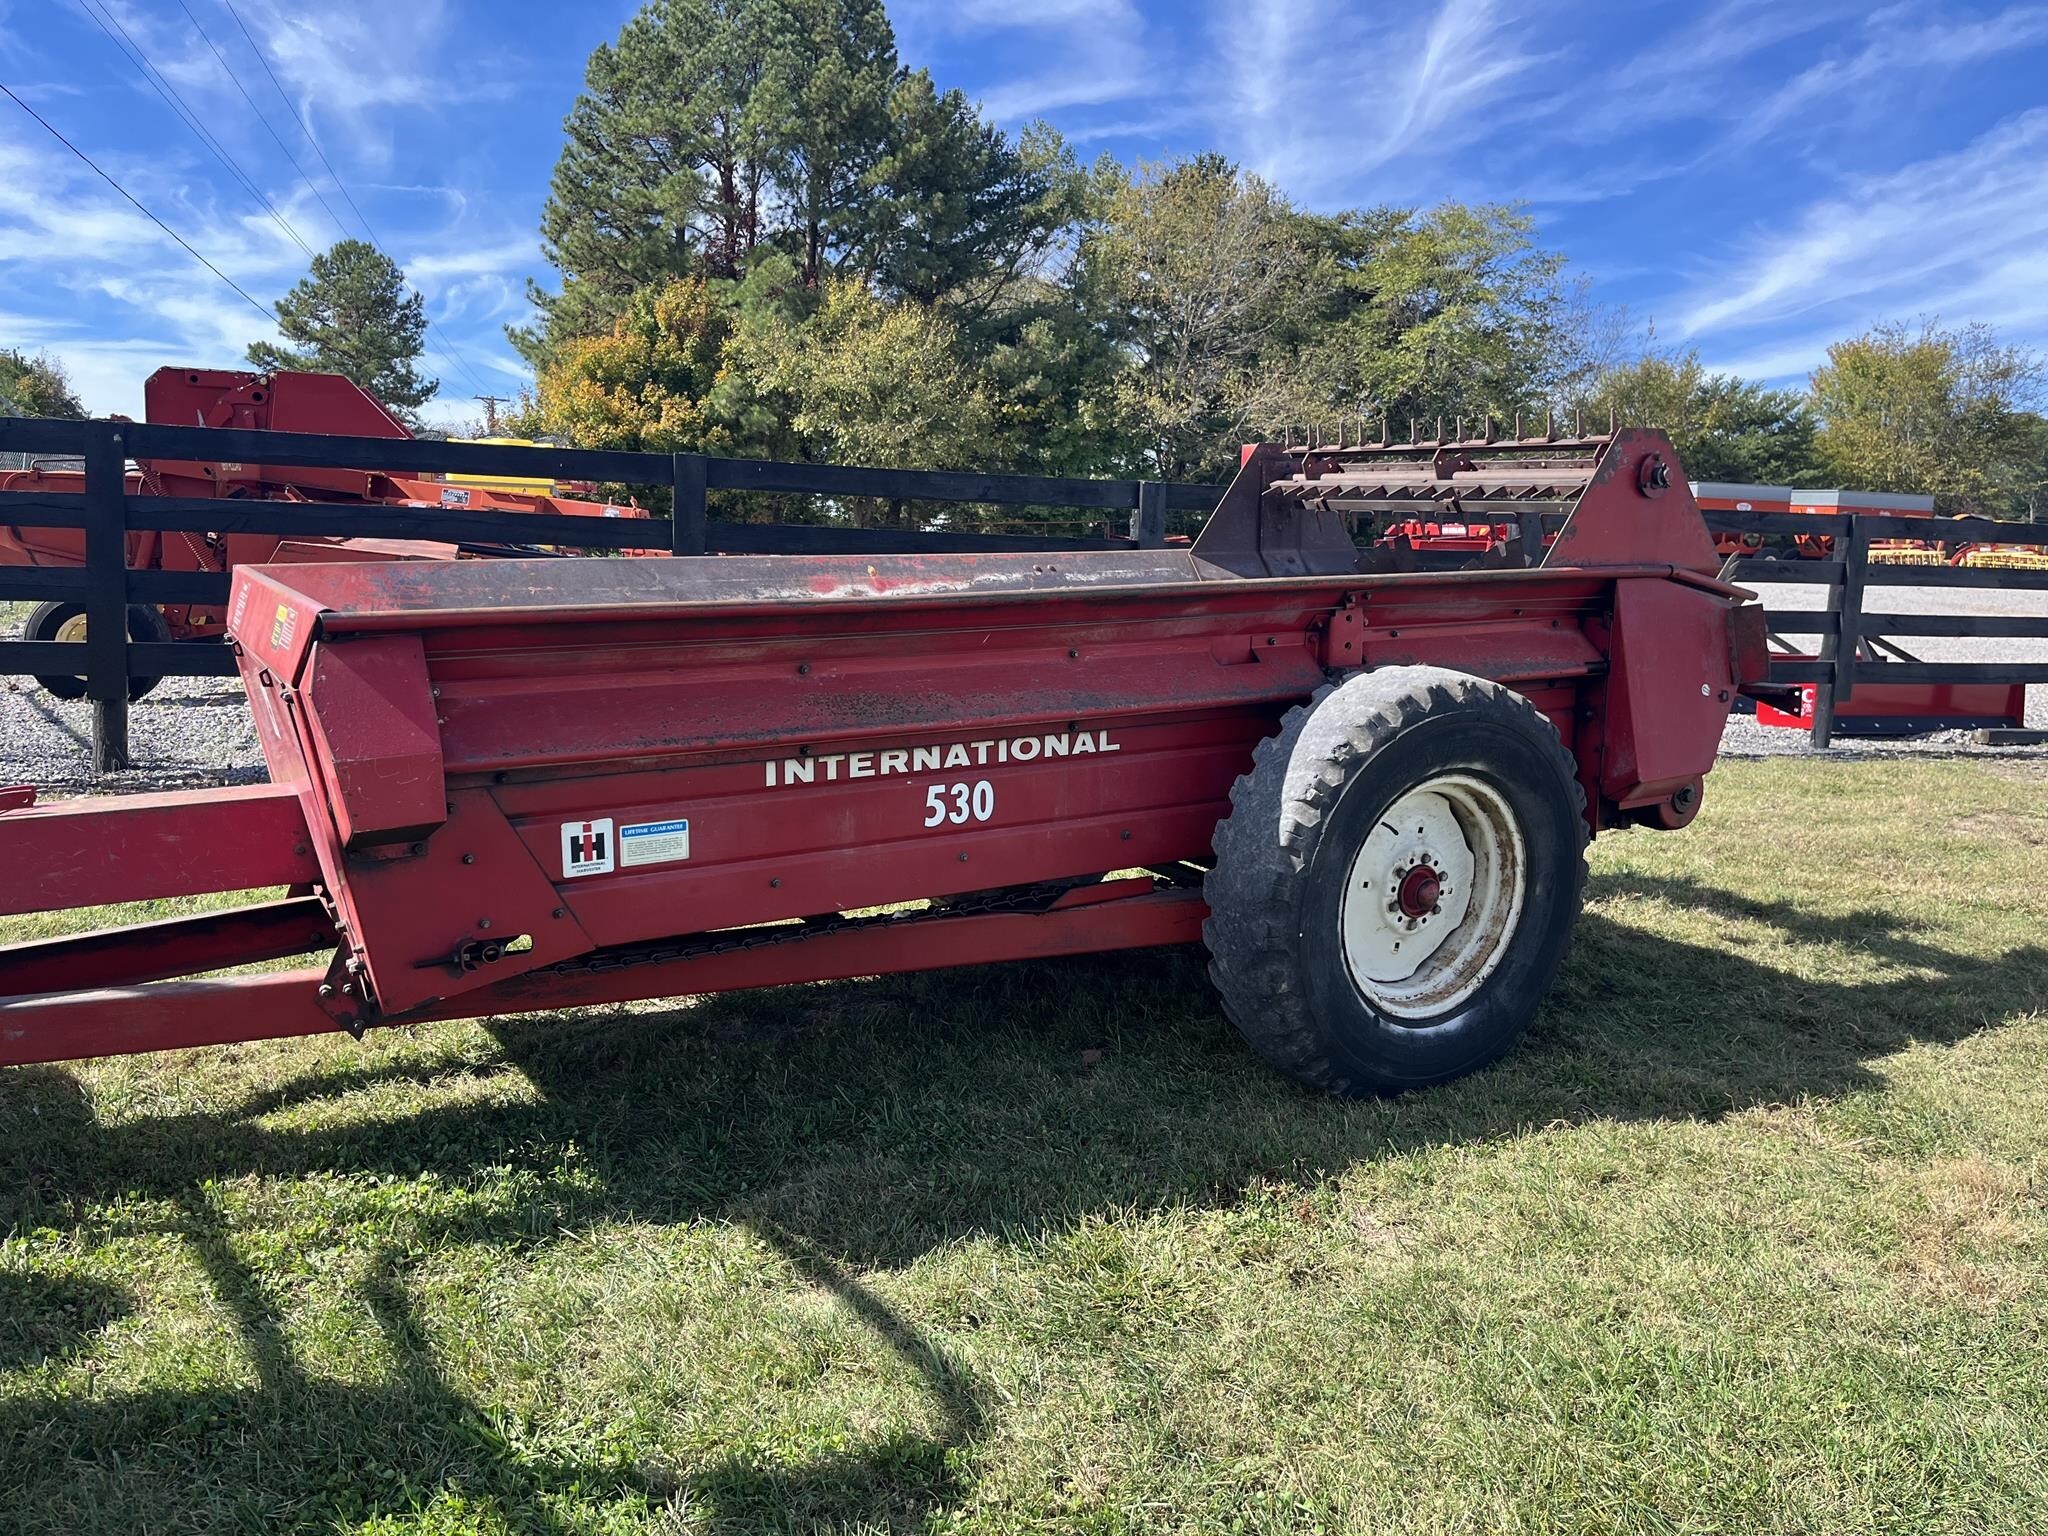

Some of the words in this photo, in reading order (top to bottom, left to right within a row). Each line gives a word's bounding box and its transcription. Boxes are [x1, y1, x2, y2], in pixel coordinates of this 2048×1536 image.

[765, 730, 1120, 787] INTERNATIONAL
[923, 779, 994, 828] 530
[624, 828, 649, 836] LIFETIME
[650, 823, 684, 832] GUARANTEE
